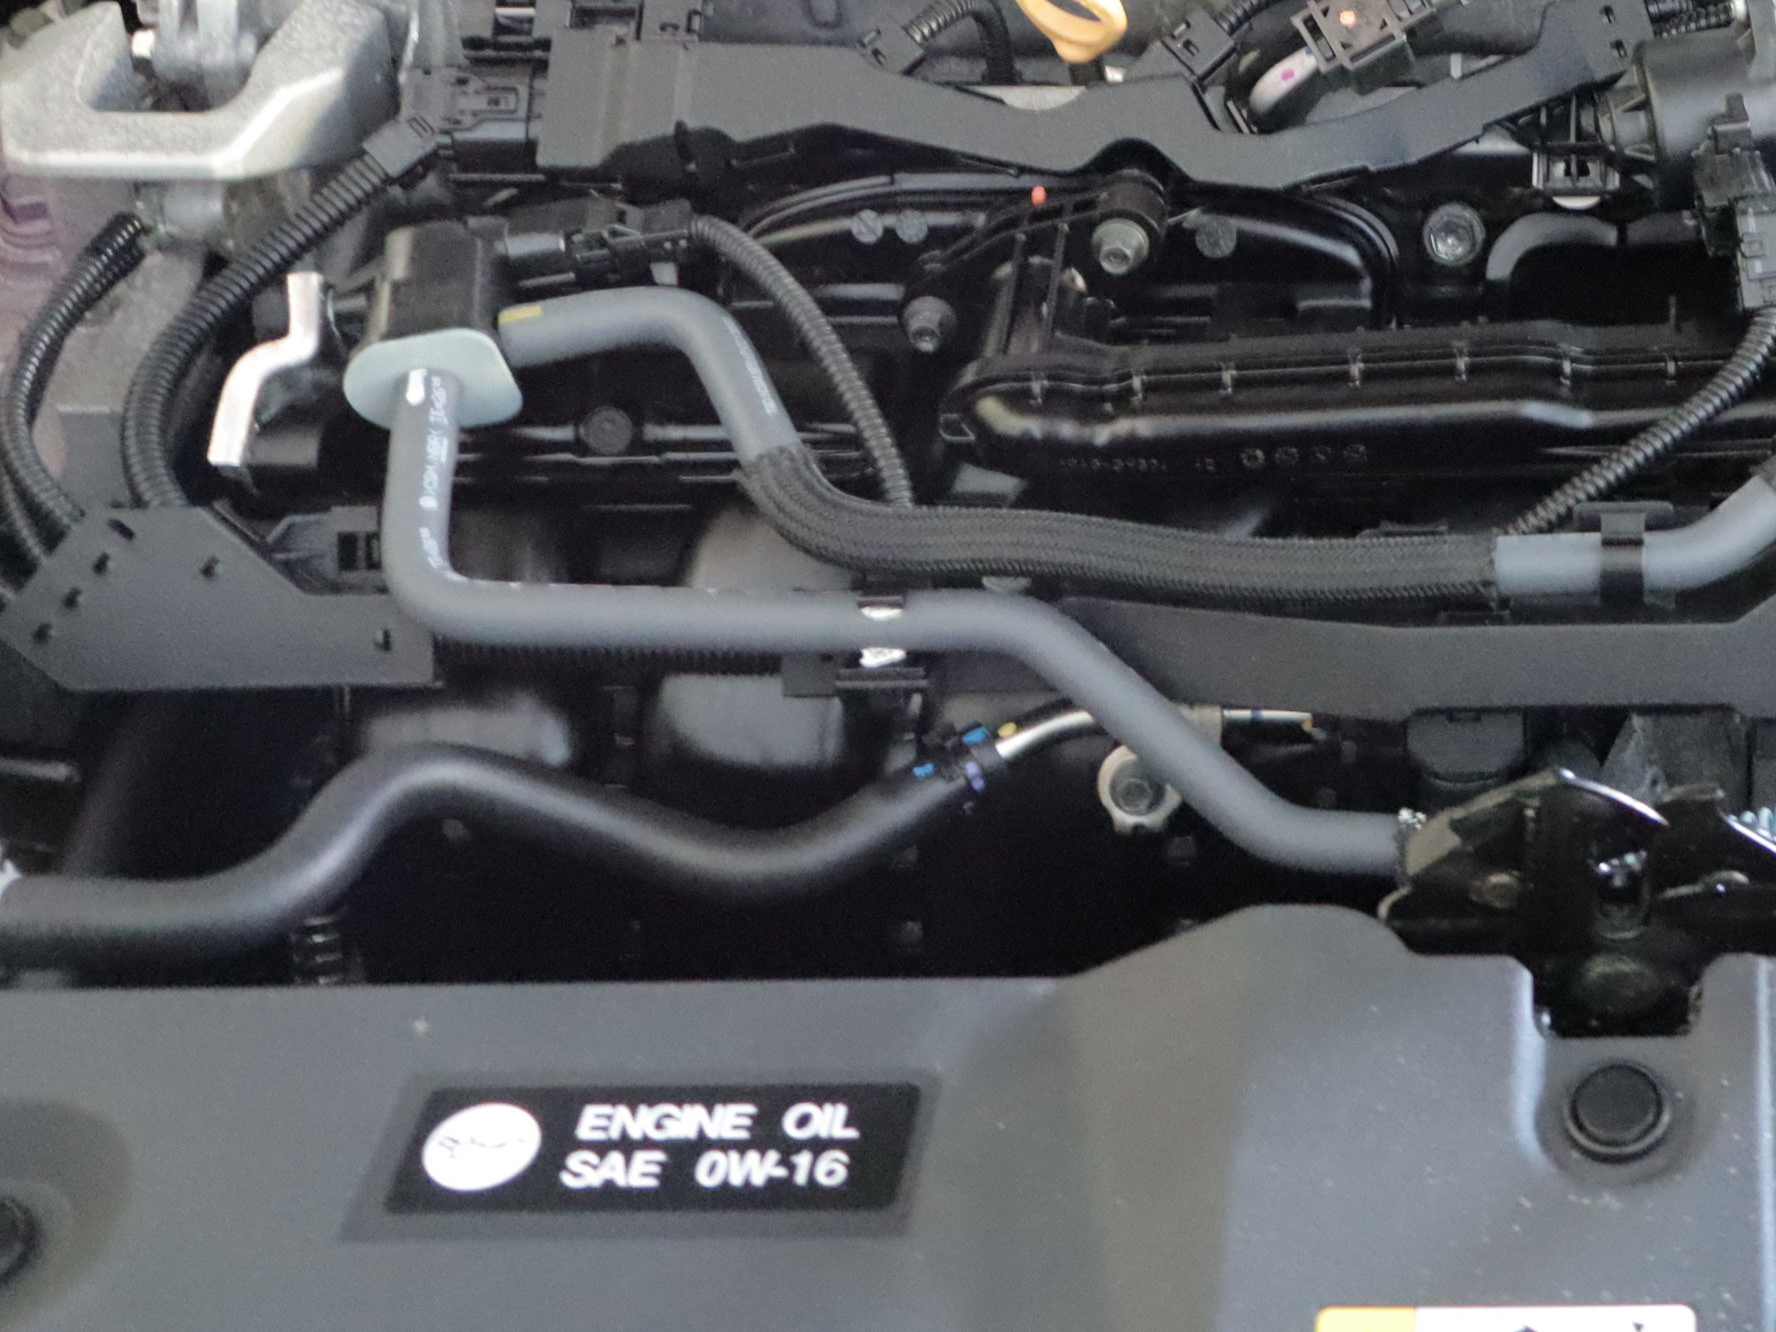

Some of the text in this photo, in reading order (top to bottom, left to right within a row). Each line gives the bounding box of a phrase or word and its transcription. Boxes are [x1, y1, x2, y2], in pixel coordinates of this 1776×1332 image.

[575, 1102, 860, 1141] ENGINE OIL
[559, 1149, 850, 1189] SAE 0W-16
